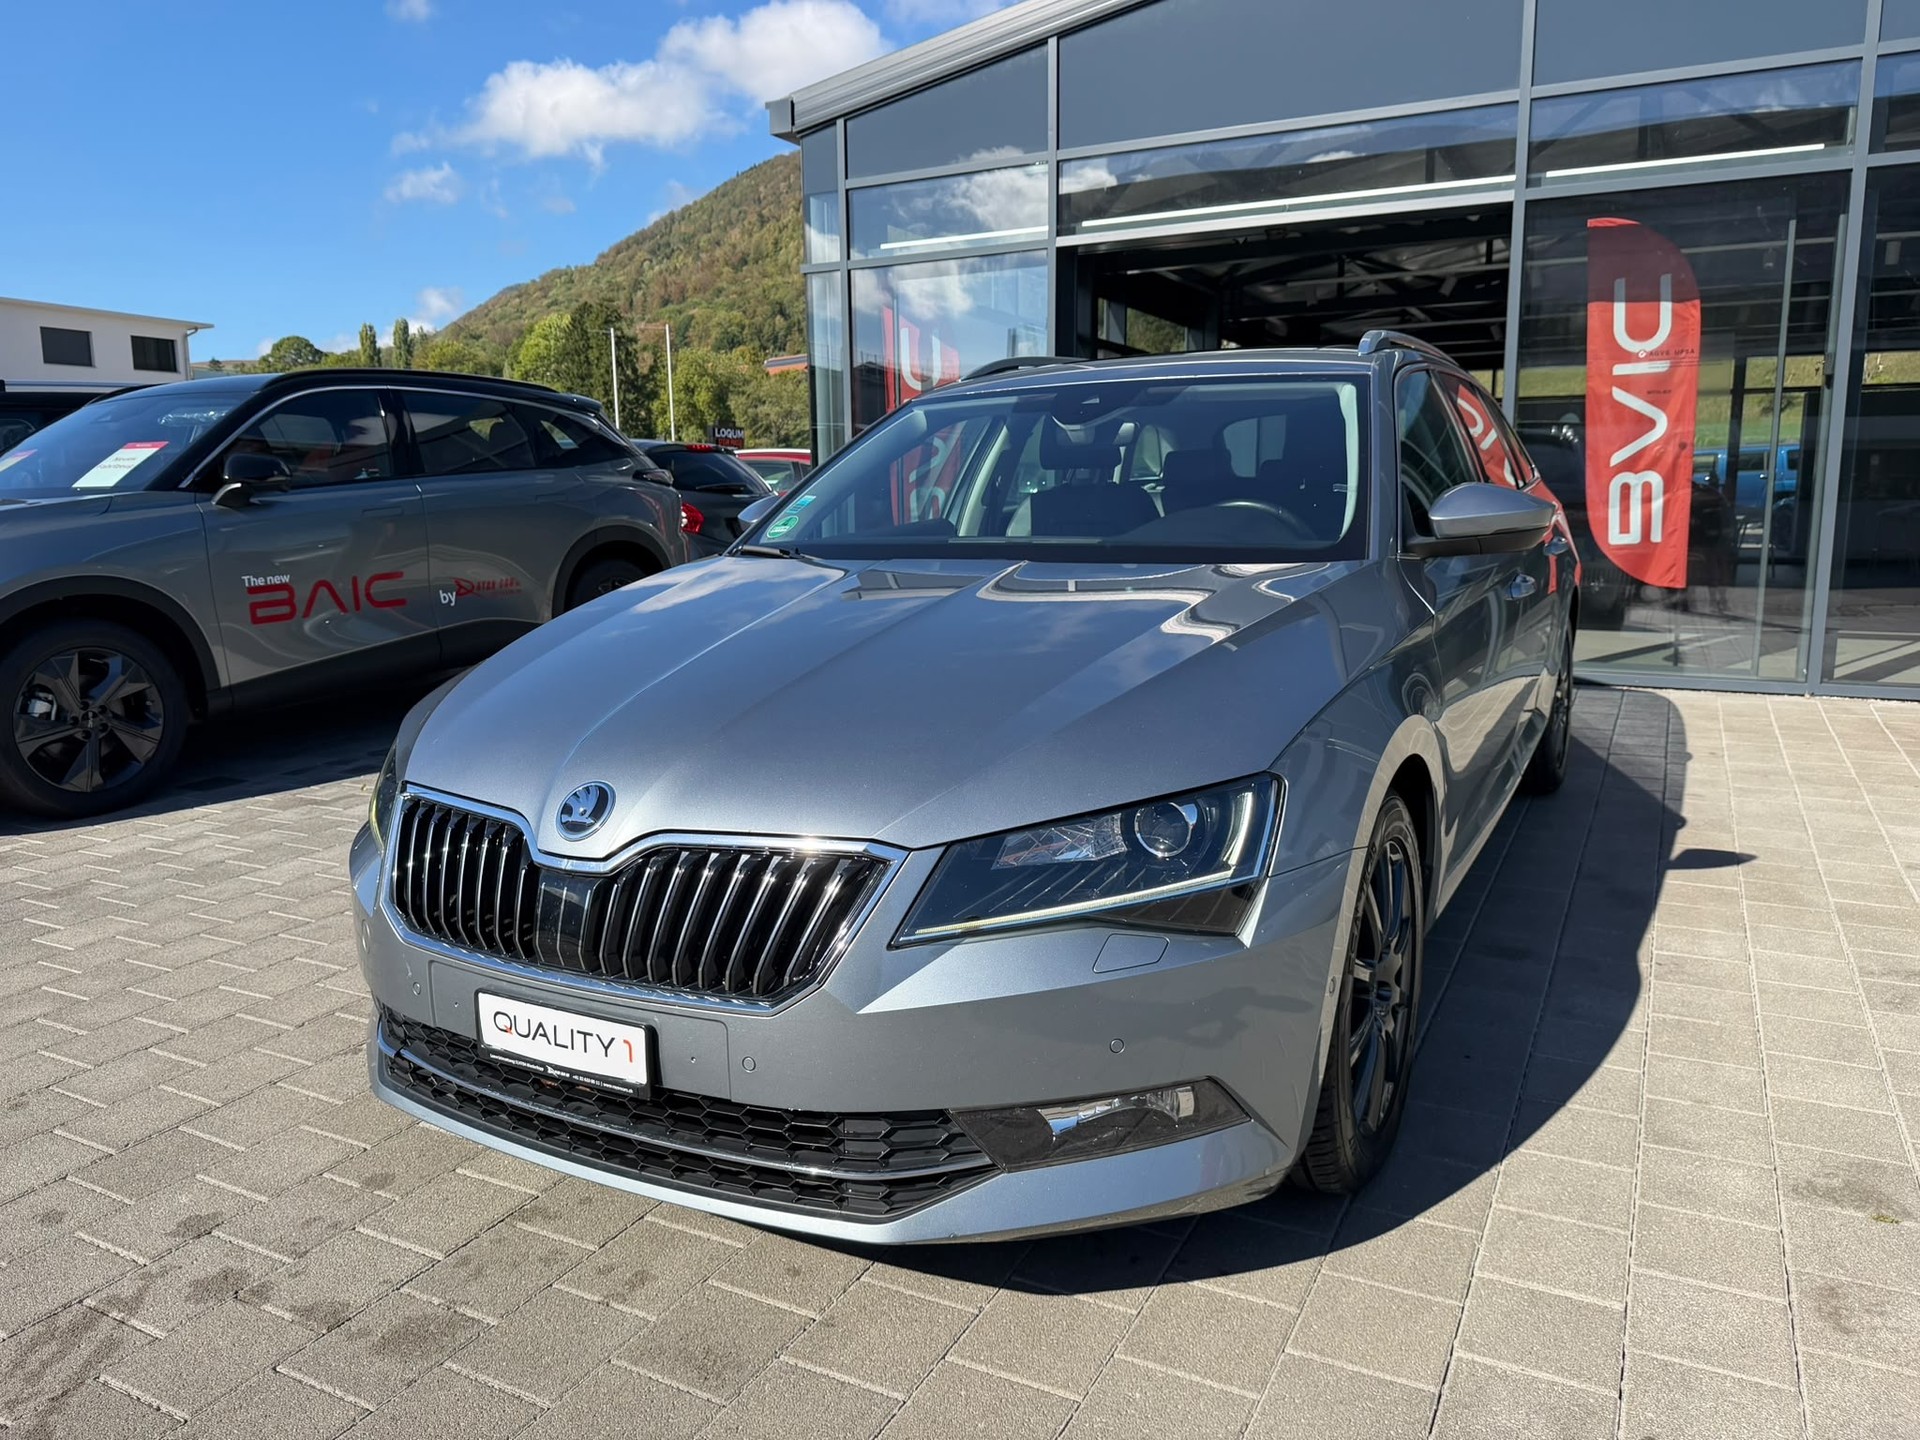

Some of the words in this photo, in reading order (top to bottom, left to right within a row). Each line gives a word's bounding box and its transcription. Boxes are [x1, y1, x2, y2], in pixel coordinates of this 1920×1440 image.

[714, 427, 744, 439] LOQUM
[241, 575, 265, 587] The
[267, 574, 290, 585] new
[247, 571, 408, 624] BAIC
[439, 589, 456, 607] by
[493, 1011, 615, 1057] QUALITY
[623, 1039, 633, 1063] 1
